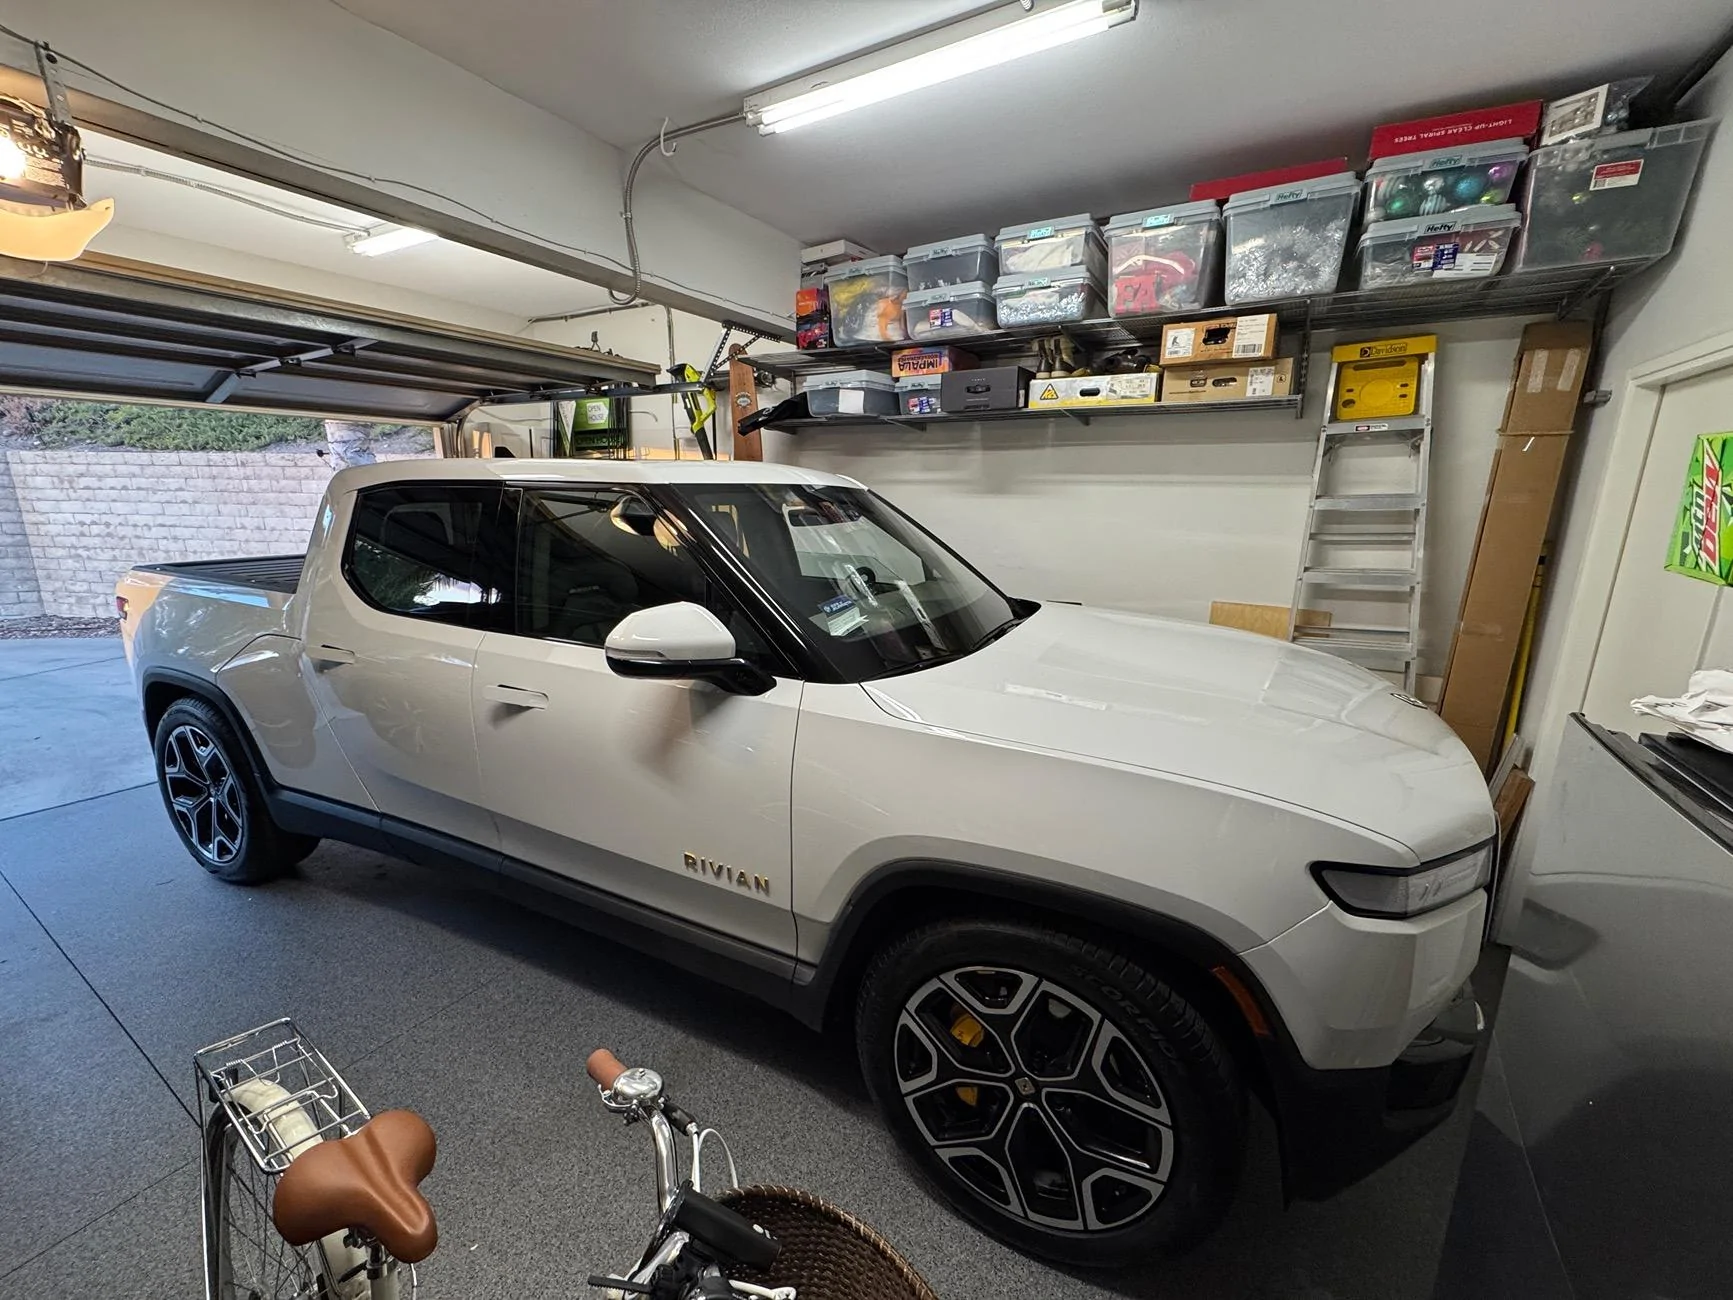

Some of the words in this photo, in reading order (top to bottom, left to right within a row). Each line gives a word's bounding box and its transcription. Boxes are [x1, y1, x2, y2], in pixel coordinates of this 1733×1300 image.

[1420, 129, 1445, 139] SPIRAL
[1426, 223, 1453, 233] Hefty
[898, 359, 938, 371] IMPALA
[683, 851, 770, 897] RIVIAN
